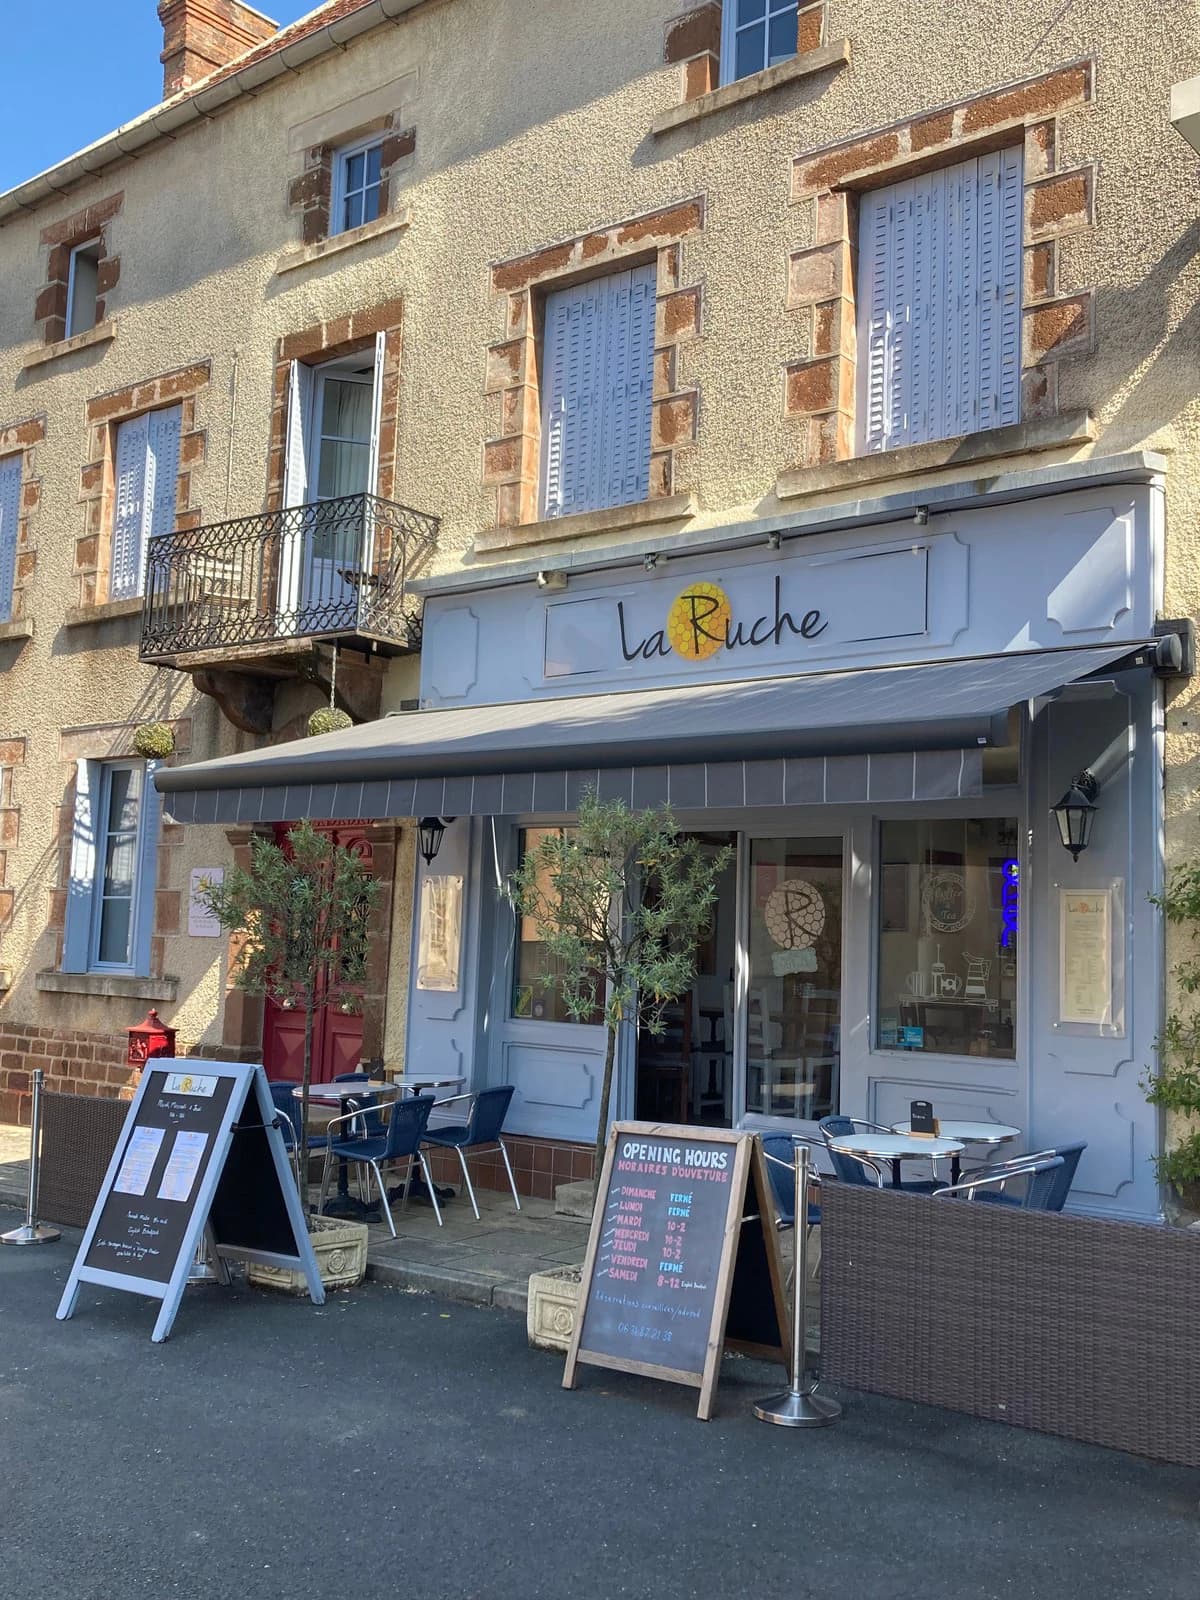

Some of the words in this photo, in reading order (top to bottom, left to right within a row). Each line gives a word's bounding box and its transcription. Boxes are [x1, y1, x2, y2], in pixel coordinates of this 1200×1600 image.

[617, 601, 672, 661] La
[680, 575, 828, 655] Ruche
[623, 1142, 681, 1165] OPENING
[684, 1148, 729, 1170] HOURS
[618, 1159, 668, 1176] HORAIRES
[671, 1165, 729, 1183] D'OUVETURE
[621, 1186, 657, 1200] DIMANCHE
[619, 1200, 643, 1213] LUNDI
[616, 1214, 643, 1227] MARDI
[614, 1228, 650, 1242] MERCREDI
[612, 1240, 637, 1253] JEUDI
[610, 1254, 649, 1269] VENDREDI
[608, 1267, 639, 1282] SAMEDI
[656, 1274, 680, 1289] 8-12
